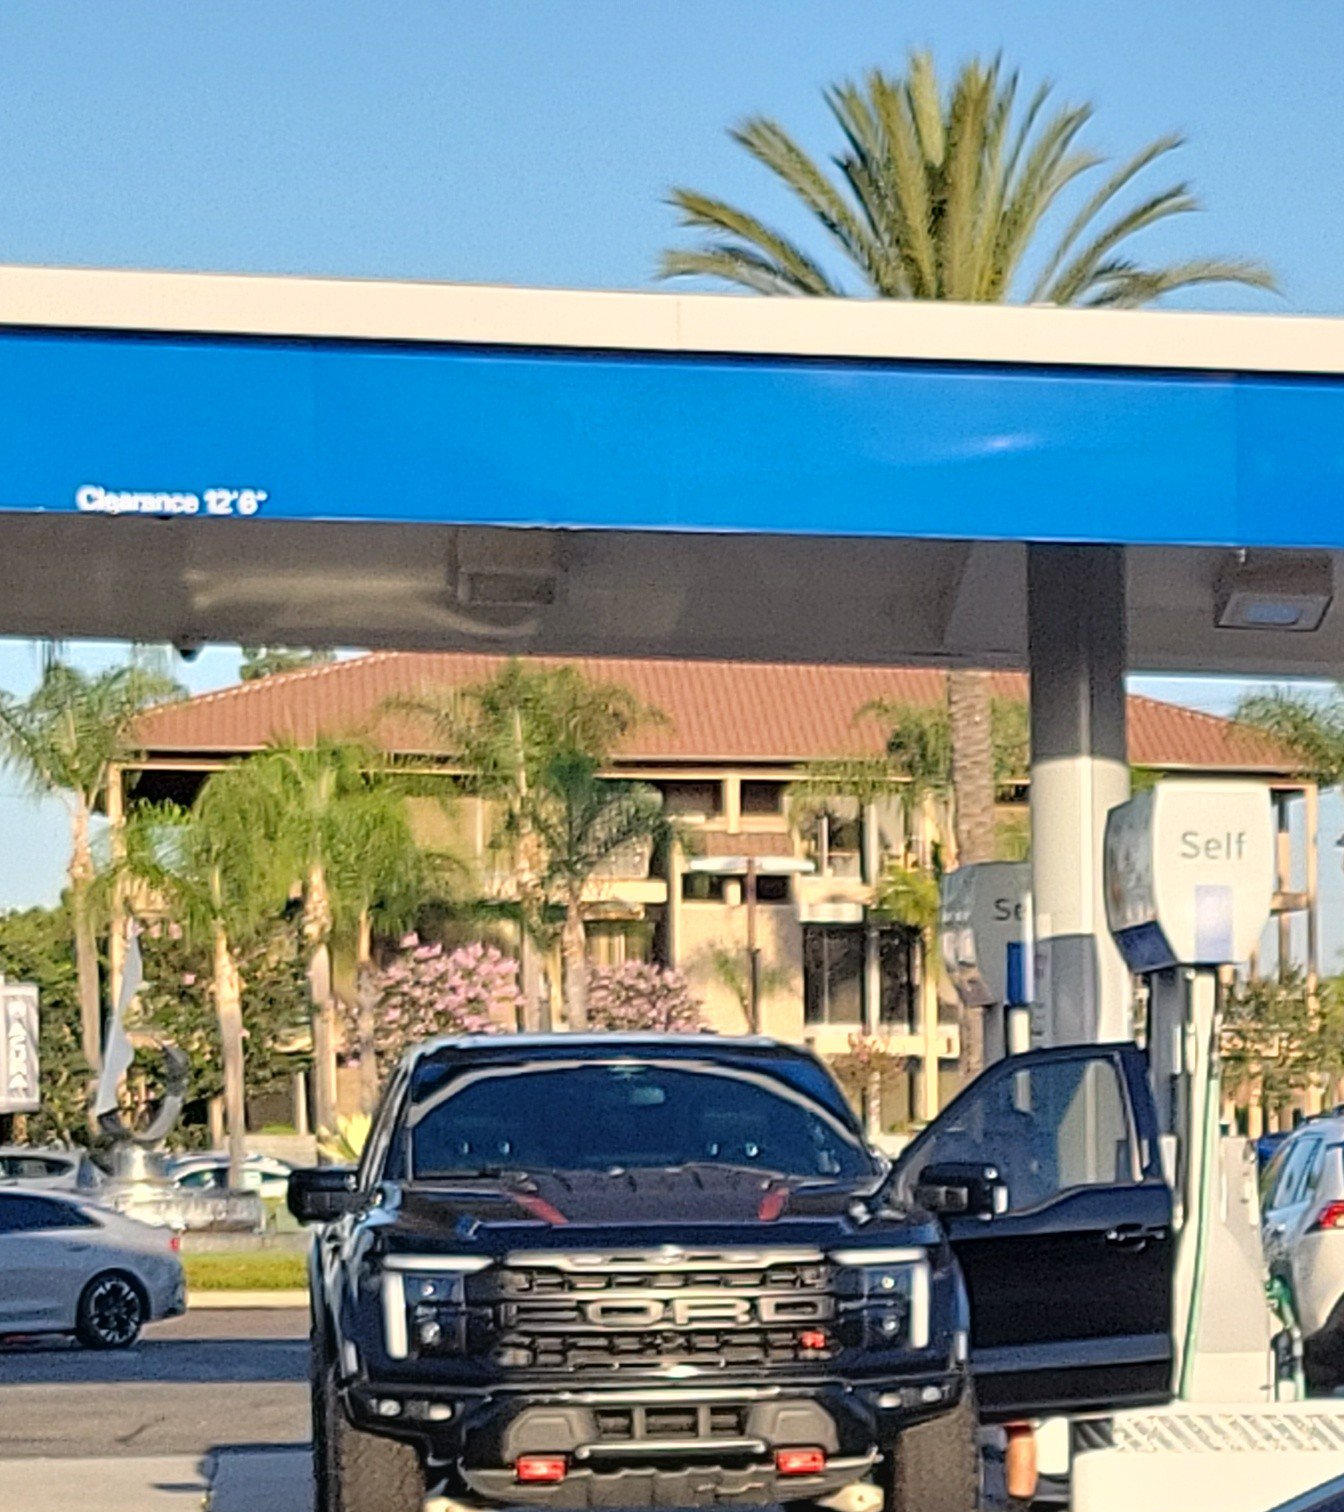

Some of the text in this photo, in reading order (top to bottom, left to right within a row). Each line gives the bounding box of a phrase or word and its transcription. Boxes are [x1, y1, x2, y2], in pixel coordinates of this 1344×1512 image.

[76, 484, 199, 514] Clearance
[1181, 831, 1246, 860] Self
[993, 898, 1023, 921] Se
[501, 1294, 836, 1328] FORD
